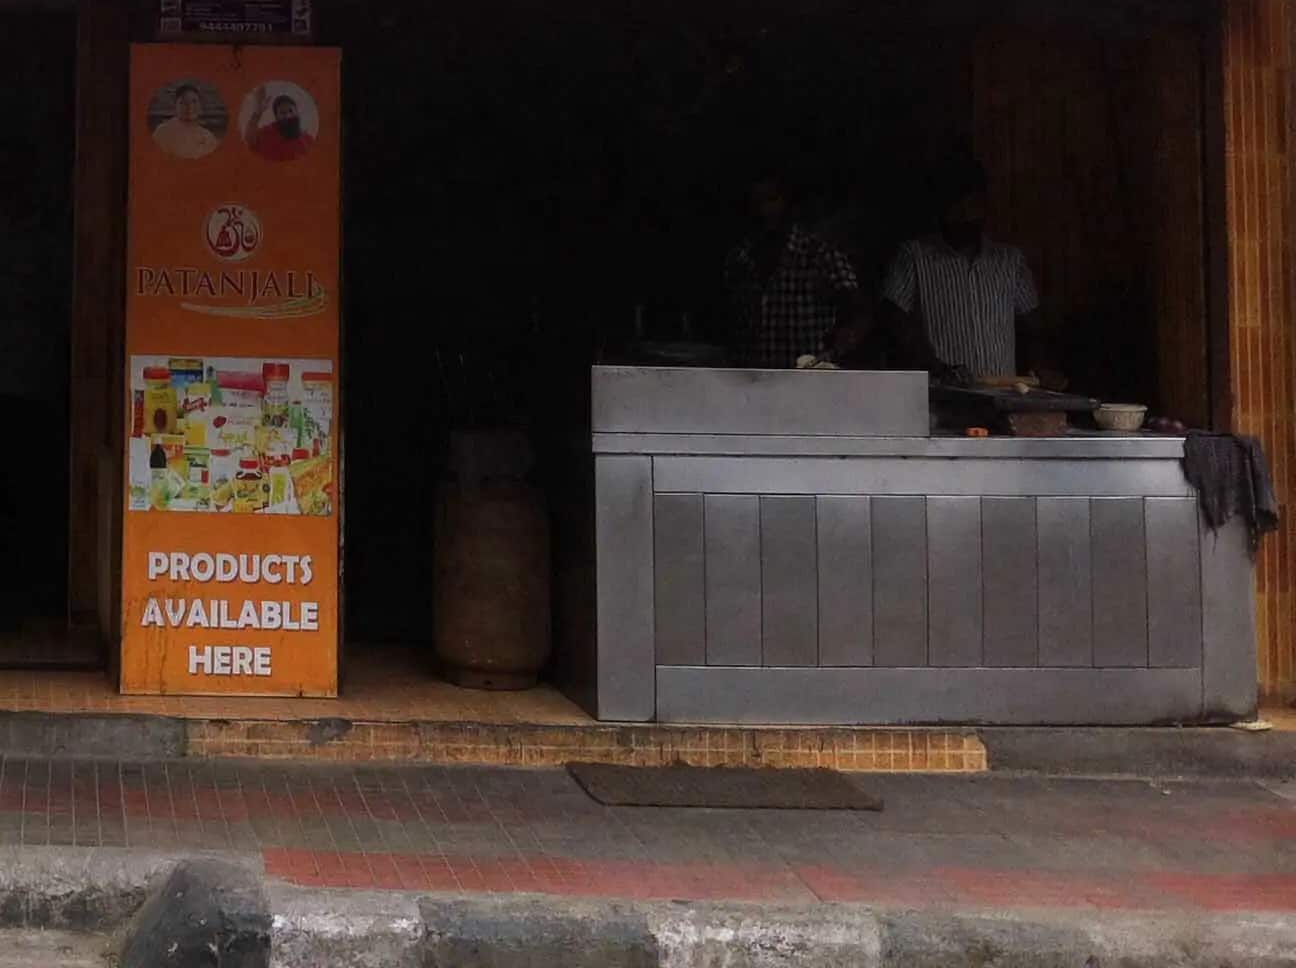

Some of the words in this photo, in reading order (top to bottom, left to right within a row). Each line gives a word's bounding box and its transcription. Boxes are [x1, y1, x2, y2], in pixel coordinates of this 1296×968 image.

[136, 265, 316, 301] PATANJALI
[148, 551, 314, 585] PRODUCTS
[140, 597, 320, 631] AVAILABLE
[188, 645, 273, 676] HERE
